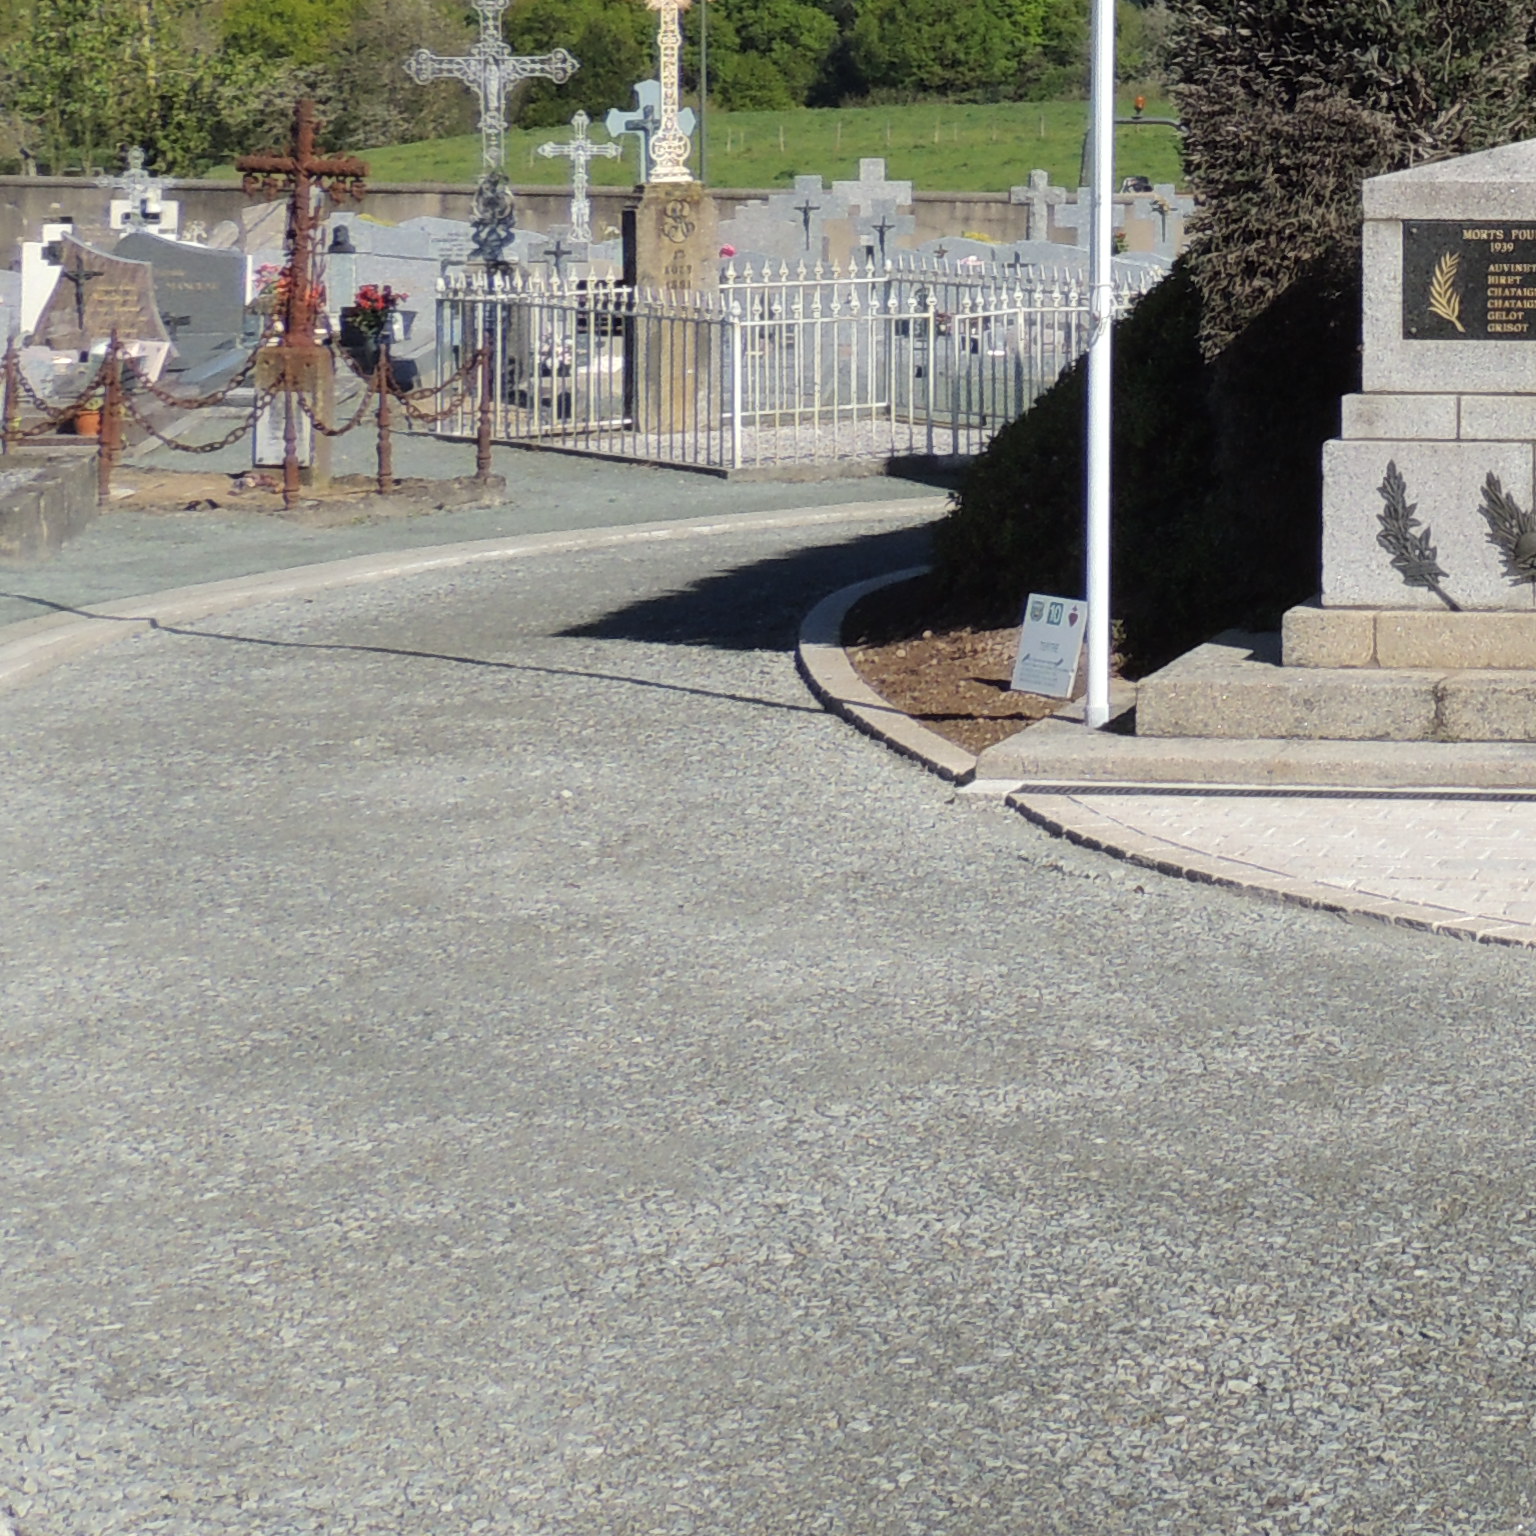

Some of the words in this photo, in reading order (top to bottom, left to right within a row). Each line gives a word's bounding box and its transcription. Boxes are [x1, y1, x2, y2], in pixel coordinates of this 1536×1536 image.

[1463, 230, 1504, 240] MORTS
[1490, 242, 1514, 253] 1939
[1487, 311, 1524, 320] GELOT
[1487, 323, 1529, 332] GRISOT
